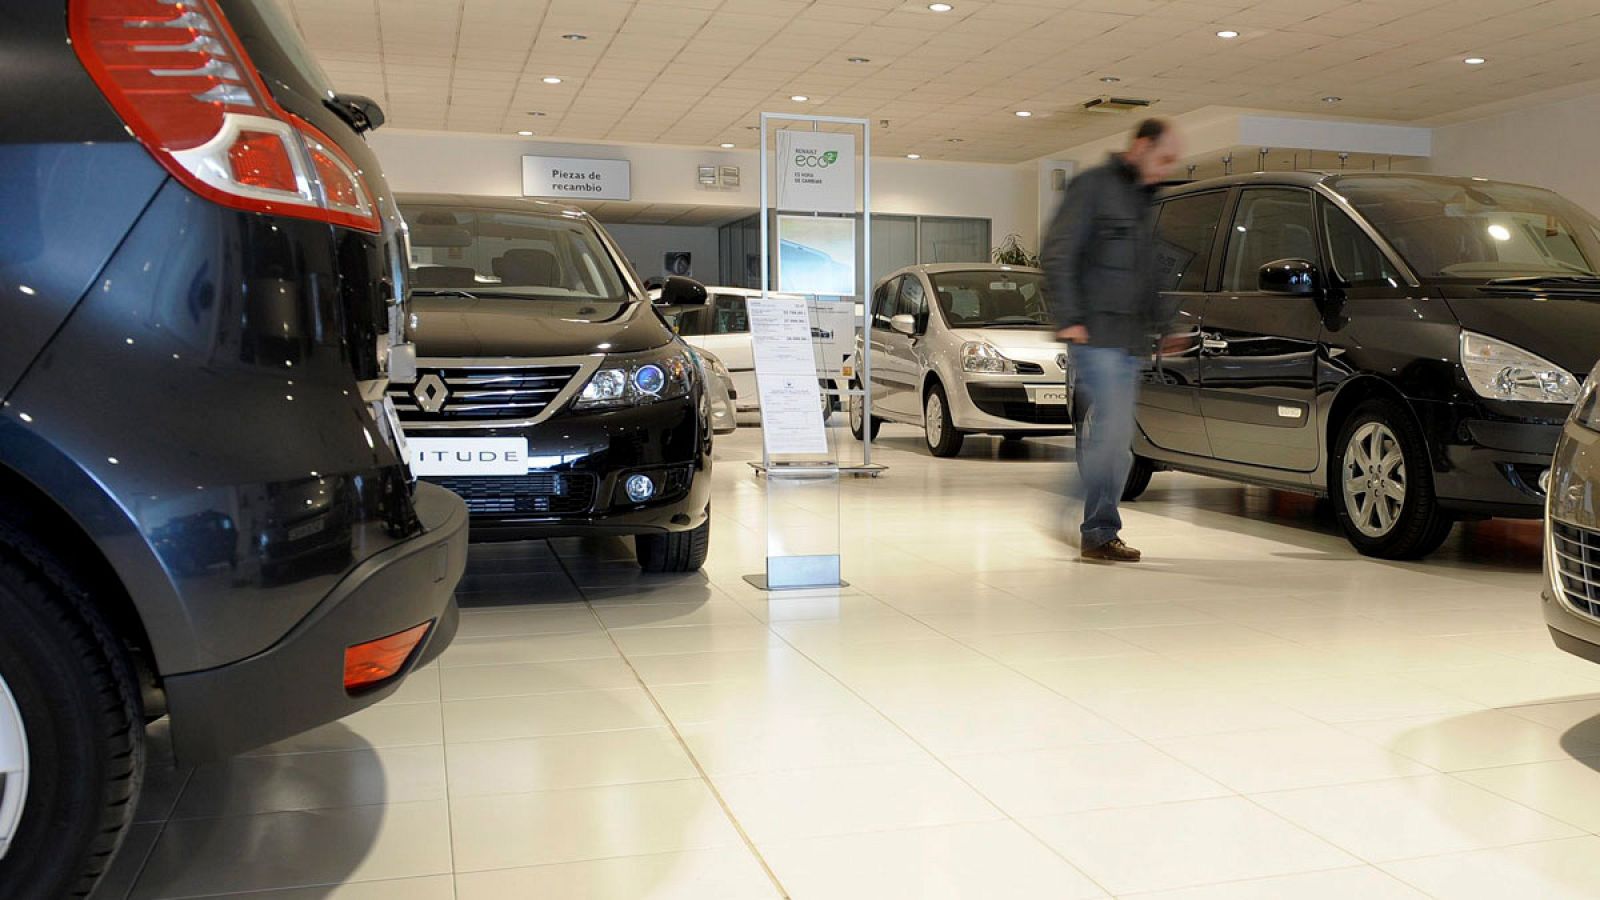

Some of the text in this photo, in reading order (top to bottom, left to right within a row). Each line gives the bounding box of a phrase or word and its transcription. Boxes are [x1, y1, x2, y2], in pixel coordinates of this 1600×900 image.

[551, 169, 601, 181] Piezas de
[551, 183, 603, 193] recambio
[1043, 392, 1067, 400] mo
[419, 451, 520, 462] ITUDE
